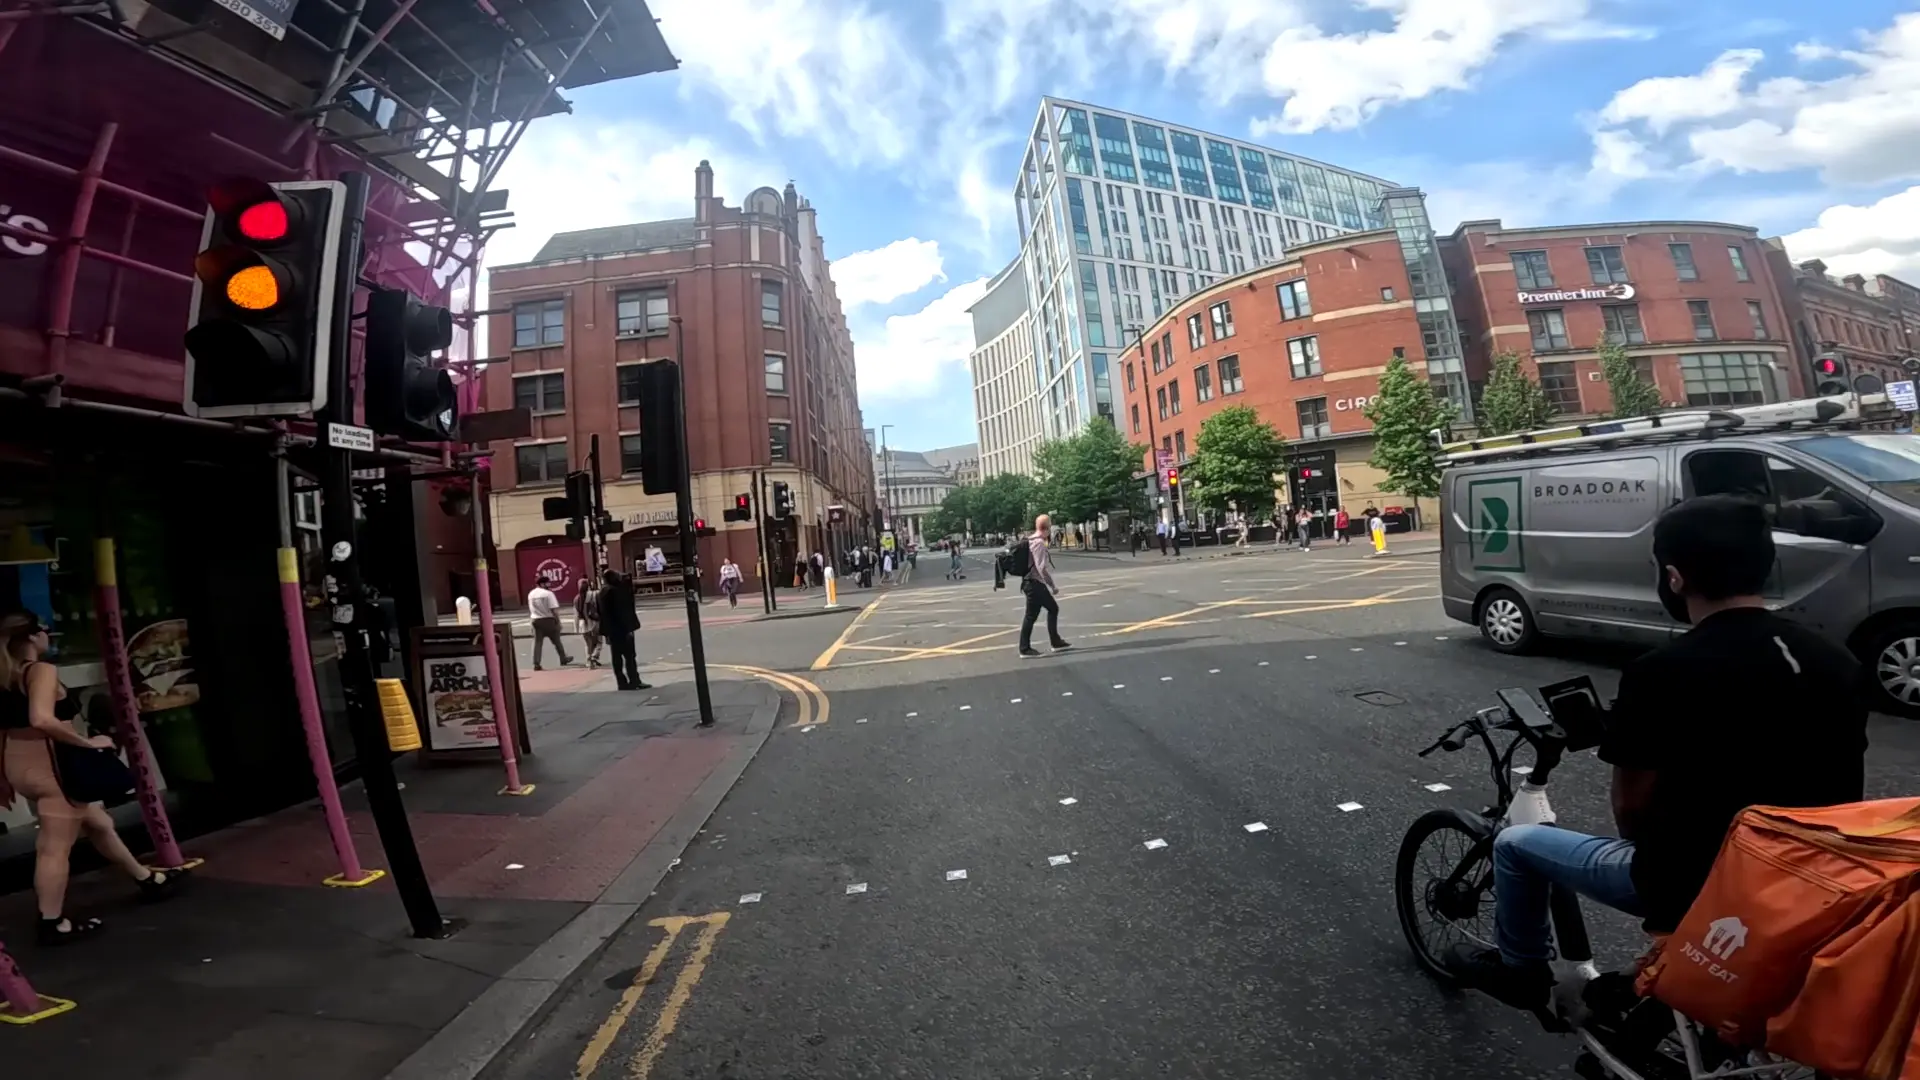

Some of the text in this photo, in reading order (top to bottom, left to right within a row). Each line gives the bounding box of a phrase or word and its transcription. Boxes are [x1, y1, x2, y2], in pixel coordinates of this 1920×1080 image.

[253, 12, 279, 36] 351
[1517, 288, 1607, 304] Premier Inn
[332, 426, 370, 440] No loading
[342, 438, 353, 447] any
[355, 439, 371, 448] time
[1534, 480, 1646, 498] BROADOAK
[430, 662, 467, 679] BIG
[428, 675, 491, 694] ARCH
[1679, 941, 1739, 983] JUST EAT
